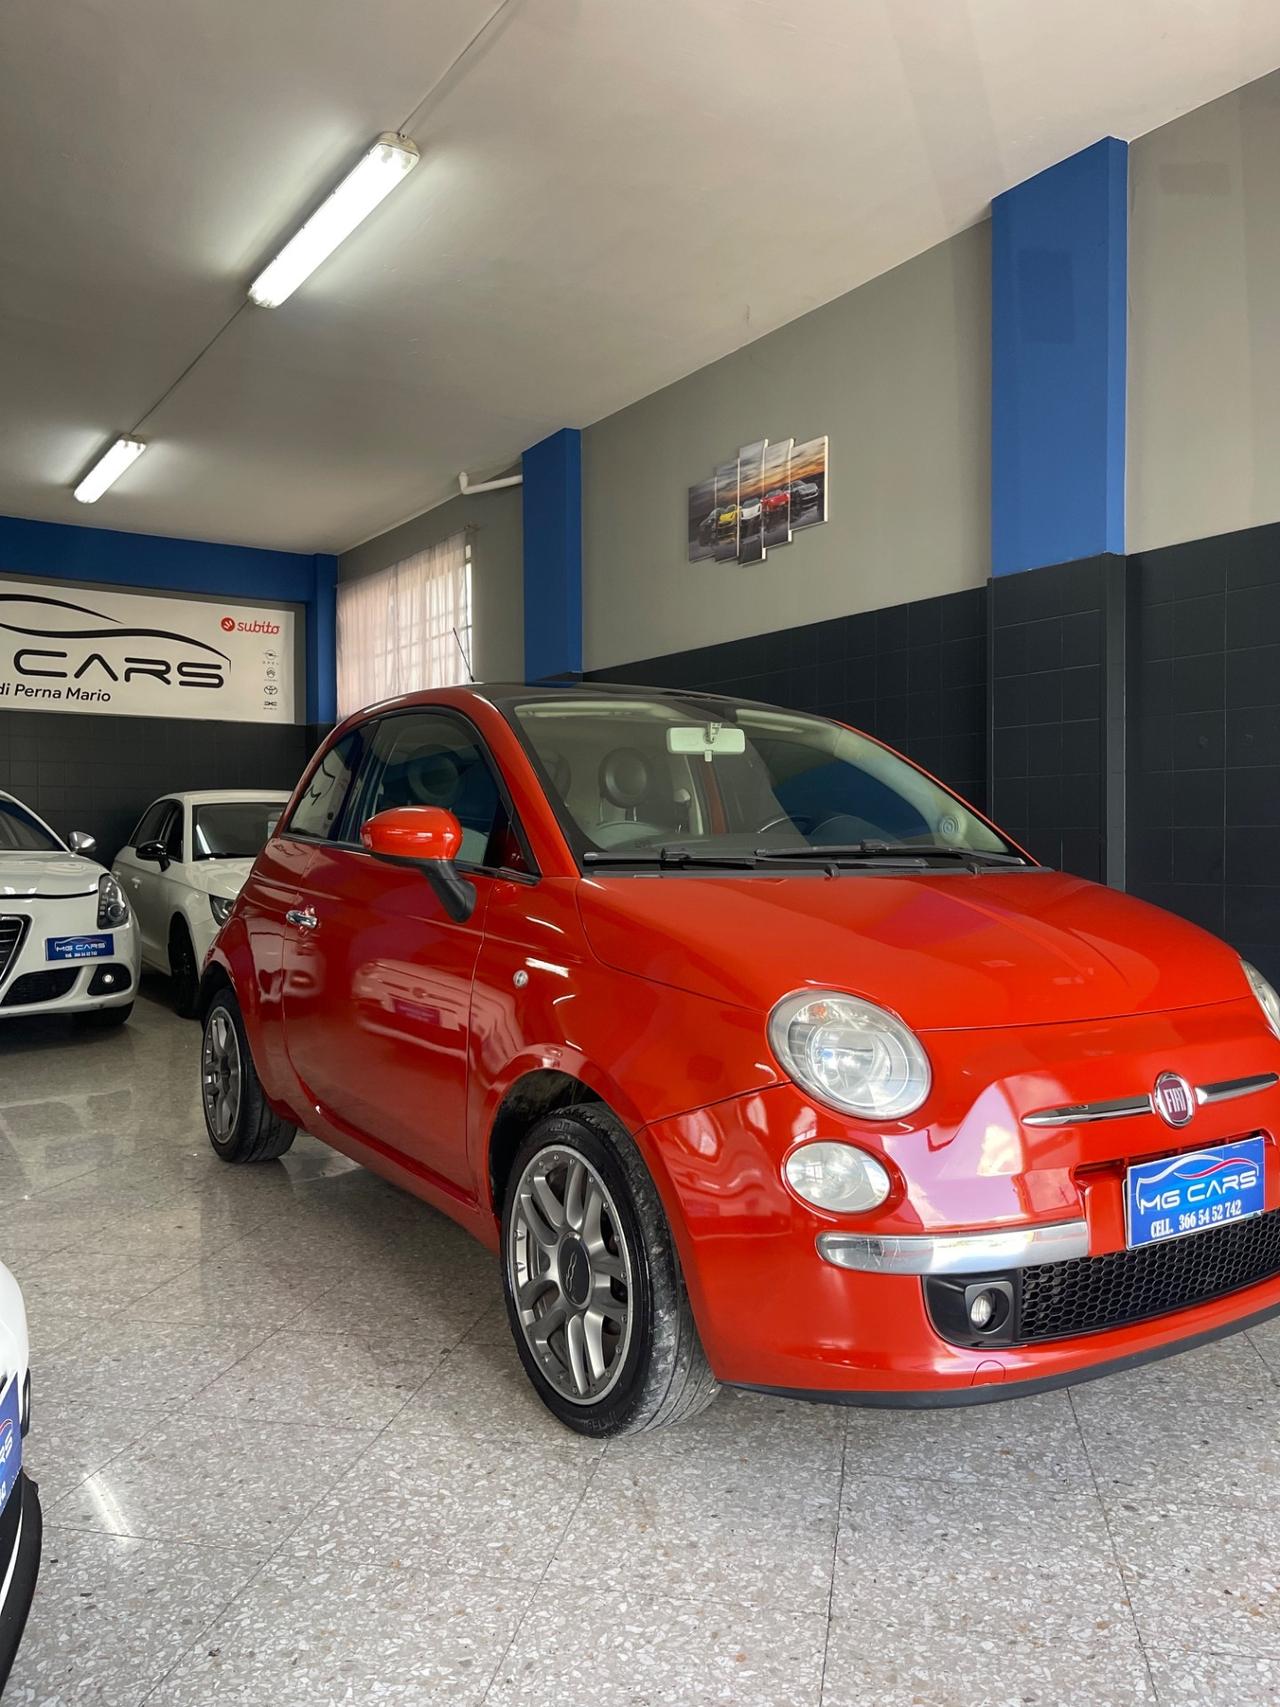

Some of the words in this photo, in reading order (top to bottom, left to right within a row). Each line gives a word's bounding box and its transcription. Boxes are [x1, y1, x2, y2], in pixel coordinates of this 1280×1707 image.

[237, 620, 281, 635] subito
[13, 648, 224, 689] CARS
[14, 684, 61, 699] Perna
[66, 687, 111, 702] Mario
[1163, 1087, 1186, 1113] FIAT
[1140, 1189, 1180, 1215] MG
[1187, 1170, 1257, 1202] CARS
[1151, 1218, 1173, 1238] CELL.
[1179, 1210, 1196, 1231] 366
[1198, 1207, 1211, 1225] 54
[1212, 1204, 1223, 1222] 52
[1225, 1199, 1242, 1218] 742
